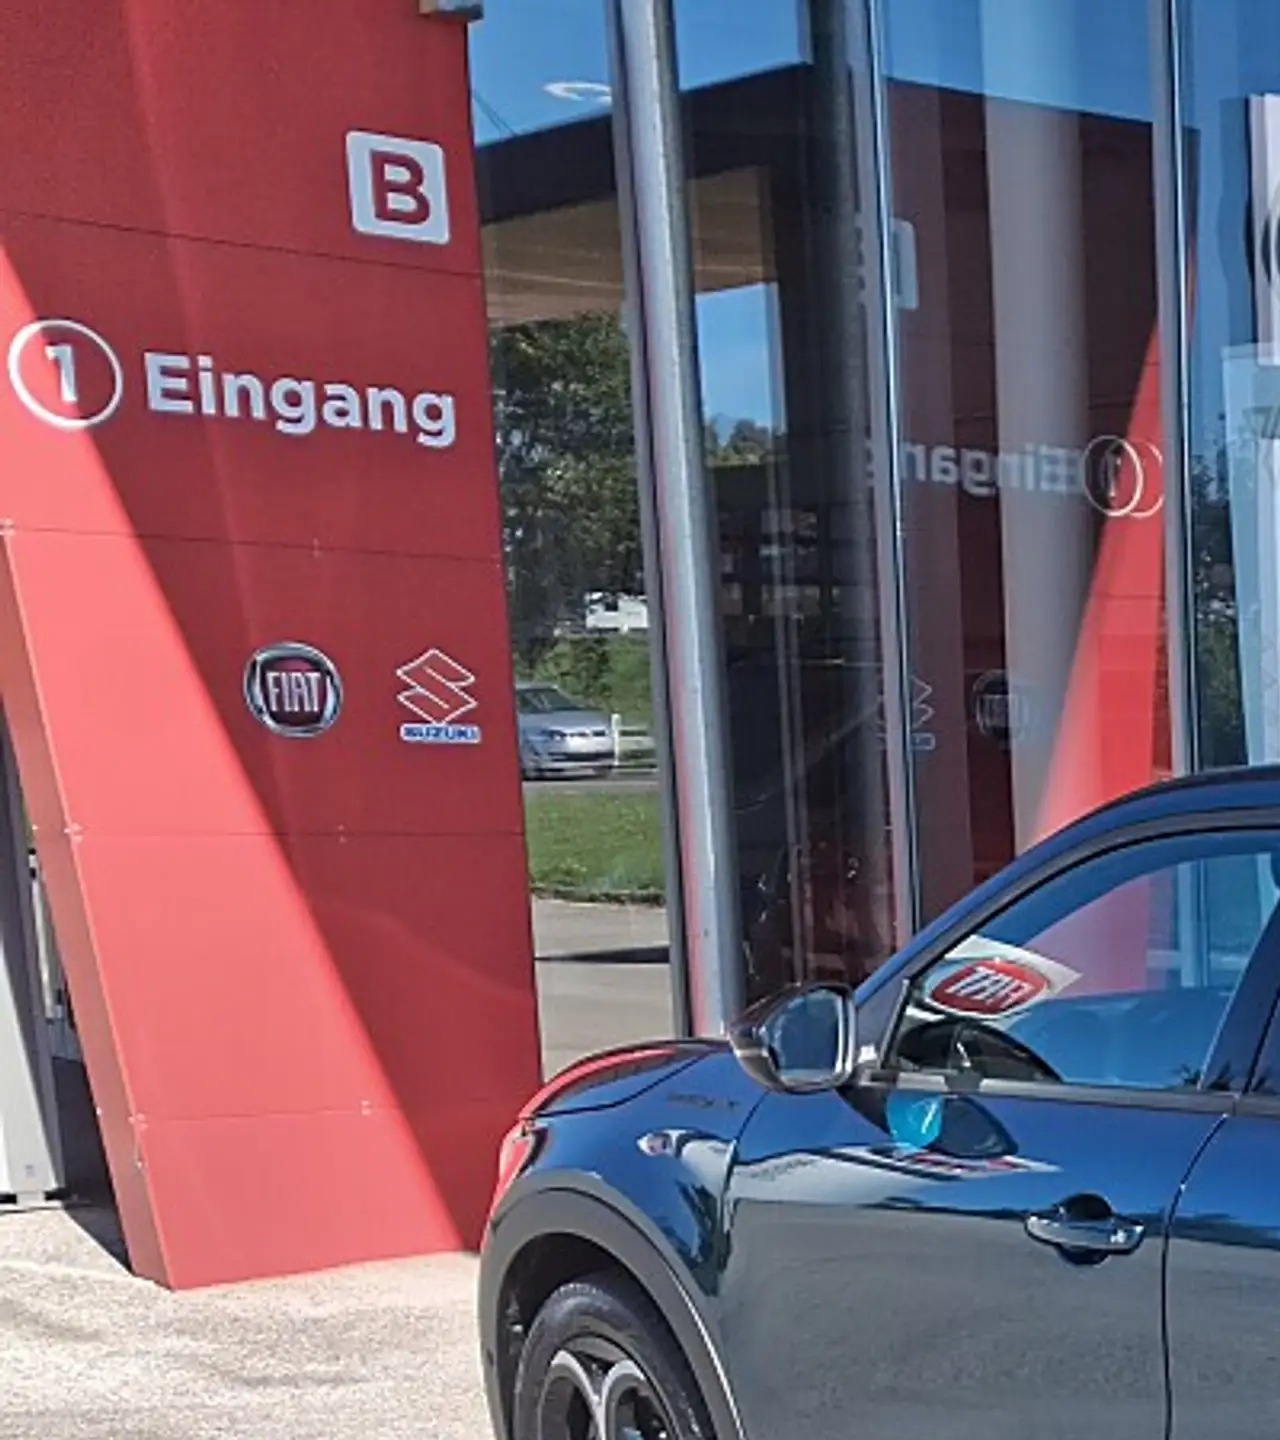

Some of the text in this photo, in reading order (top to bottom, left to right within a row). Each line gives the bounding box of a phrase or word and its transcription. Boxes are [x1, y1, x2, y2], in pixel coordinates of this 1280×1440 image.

[369, 149, 431, 226] B
[45, 344, 456, 449] 1 Eingang
[266, 671, 322, 713] FIAT
